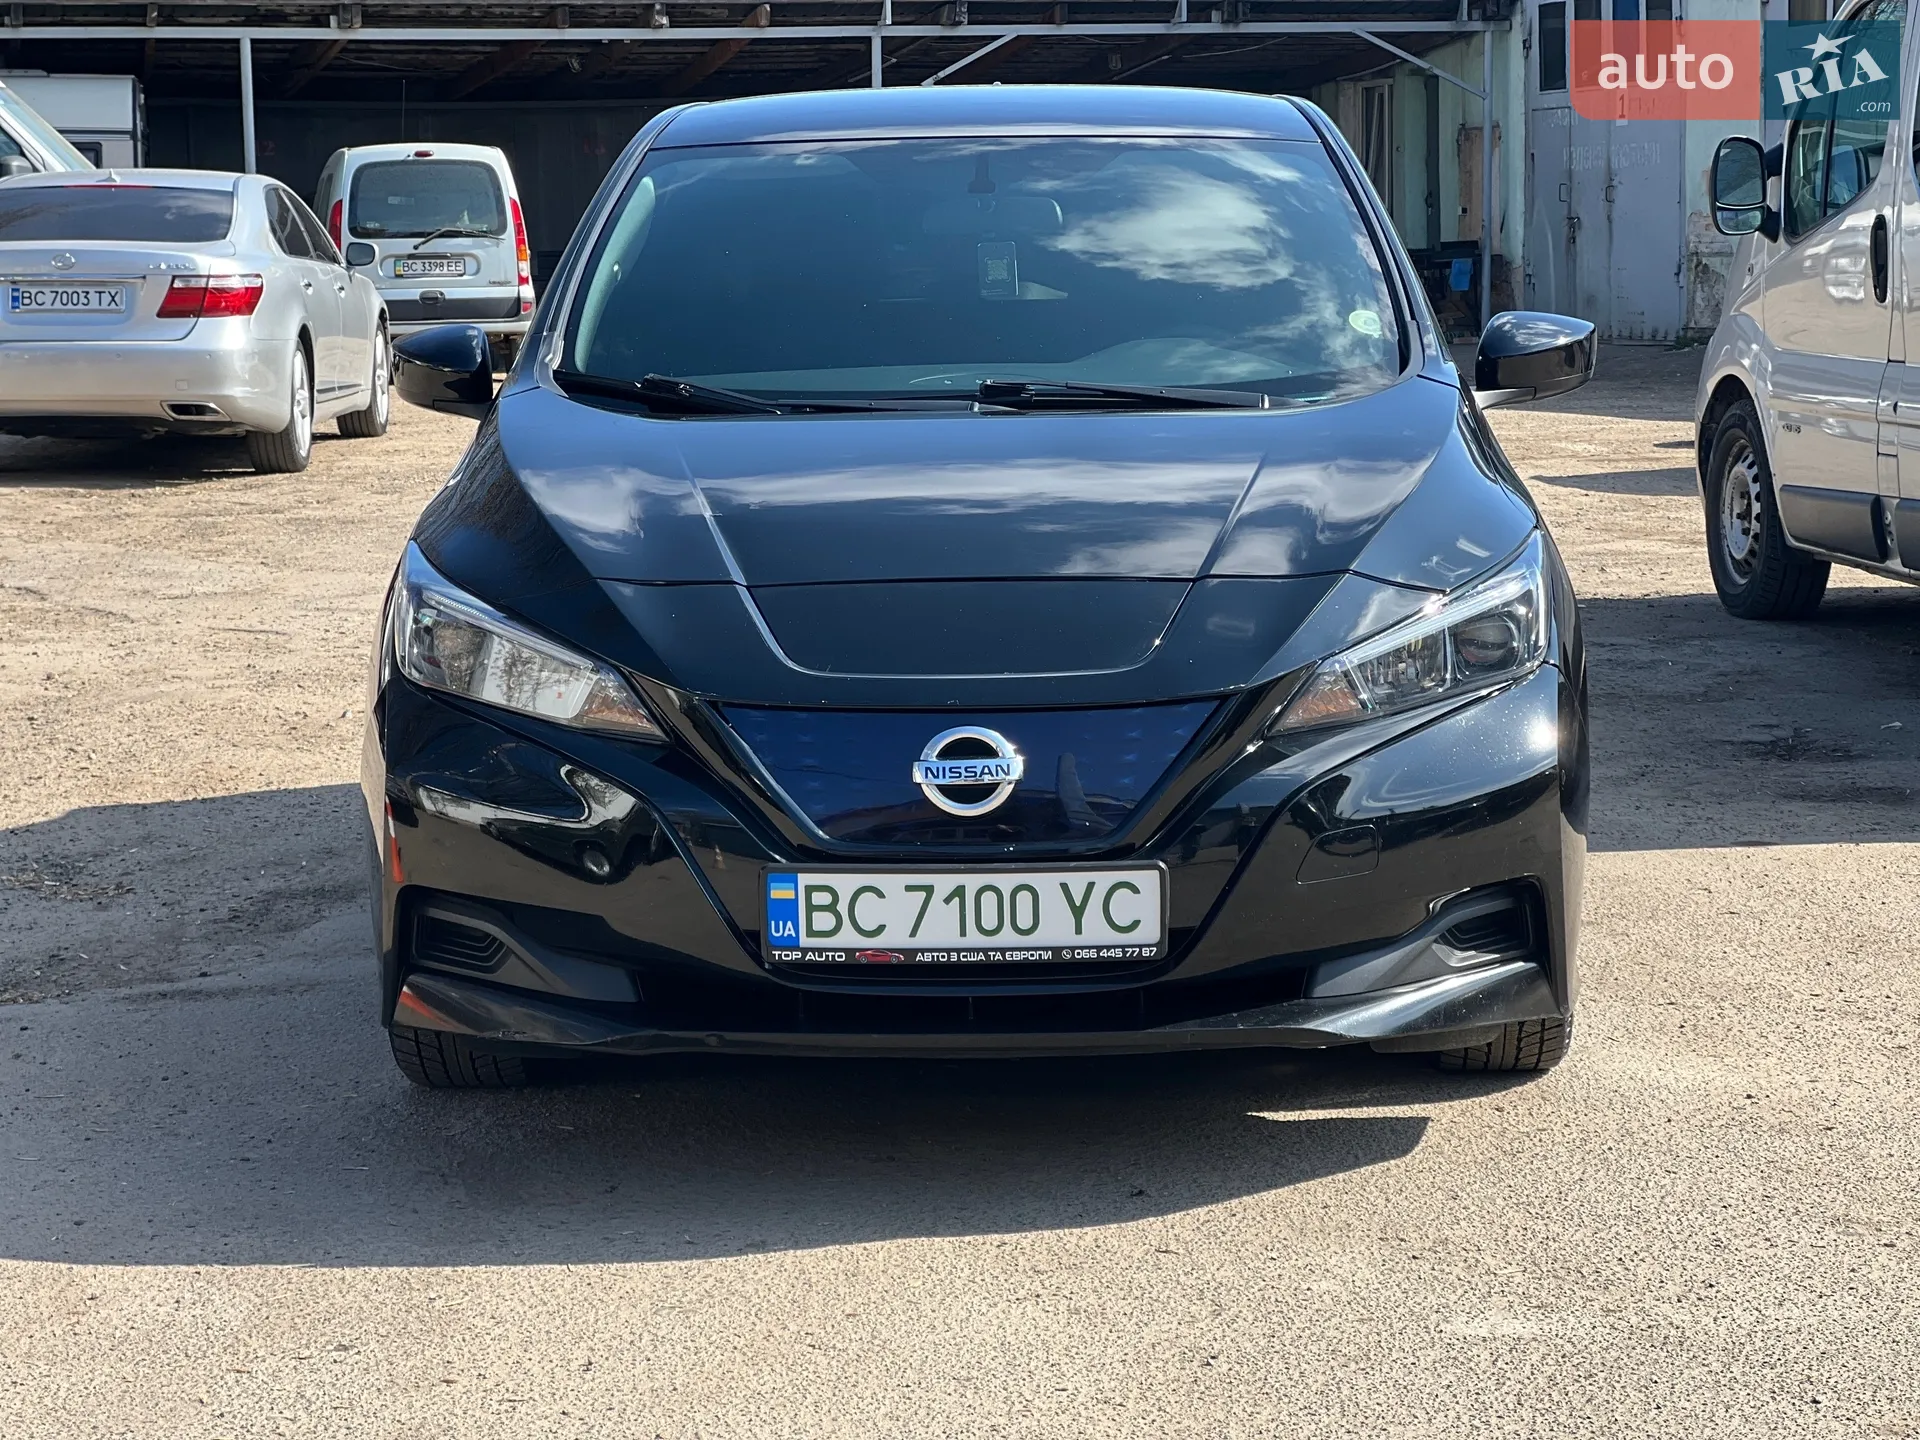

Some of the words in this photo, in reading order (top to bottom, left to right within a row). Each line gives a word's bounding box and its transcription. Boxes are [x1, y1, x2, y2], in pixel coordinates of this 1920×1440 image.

[403, 261, 418, 272] BC
[421, 261, 444, 272] 3398
[447, 261, 462, 272] EE
[21, 290, 46, 306] BC
[50, 290, 91, 306] 7003
[95, 290, 119, 306] TX
[924, 763, 1011, 780] NISSAN
[804, 883, 888, 939] BC
[904, 882, 1042, 939] 7100
[1058, 880, 1142, 936] YC
[771, 920, 796, 938] UA
[772, 950, 802, 961] TOP
[805, 951, 846, 961] AUTO
[915, 952, 948, 962] АВТО
[960, 951, 986, 962] США
[988, 951, 1004, 961] ТА
[1005, 950, 1053, 961] ЄВРОПИ
[1074, 948, 1098, 959] 066
[1099, 948, 1123, 958] 445
[1125, 947, 1140, 957] 77
[1142, 946, 1157, 957] 87
